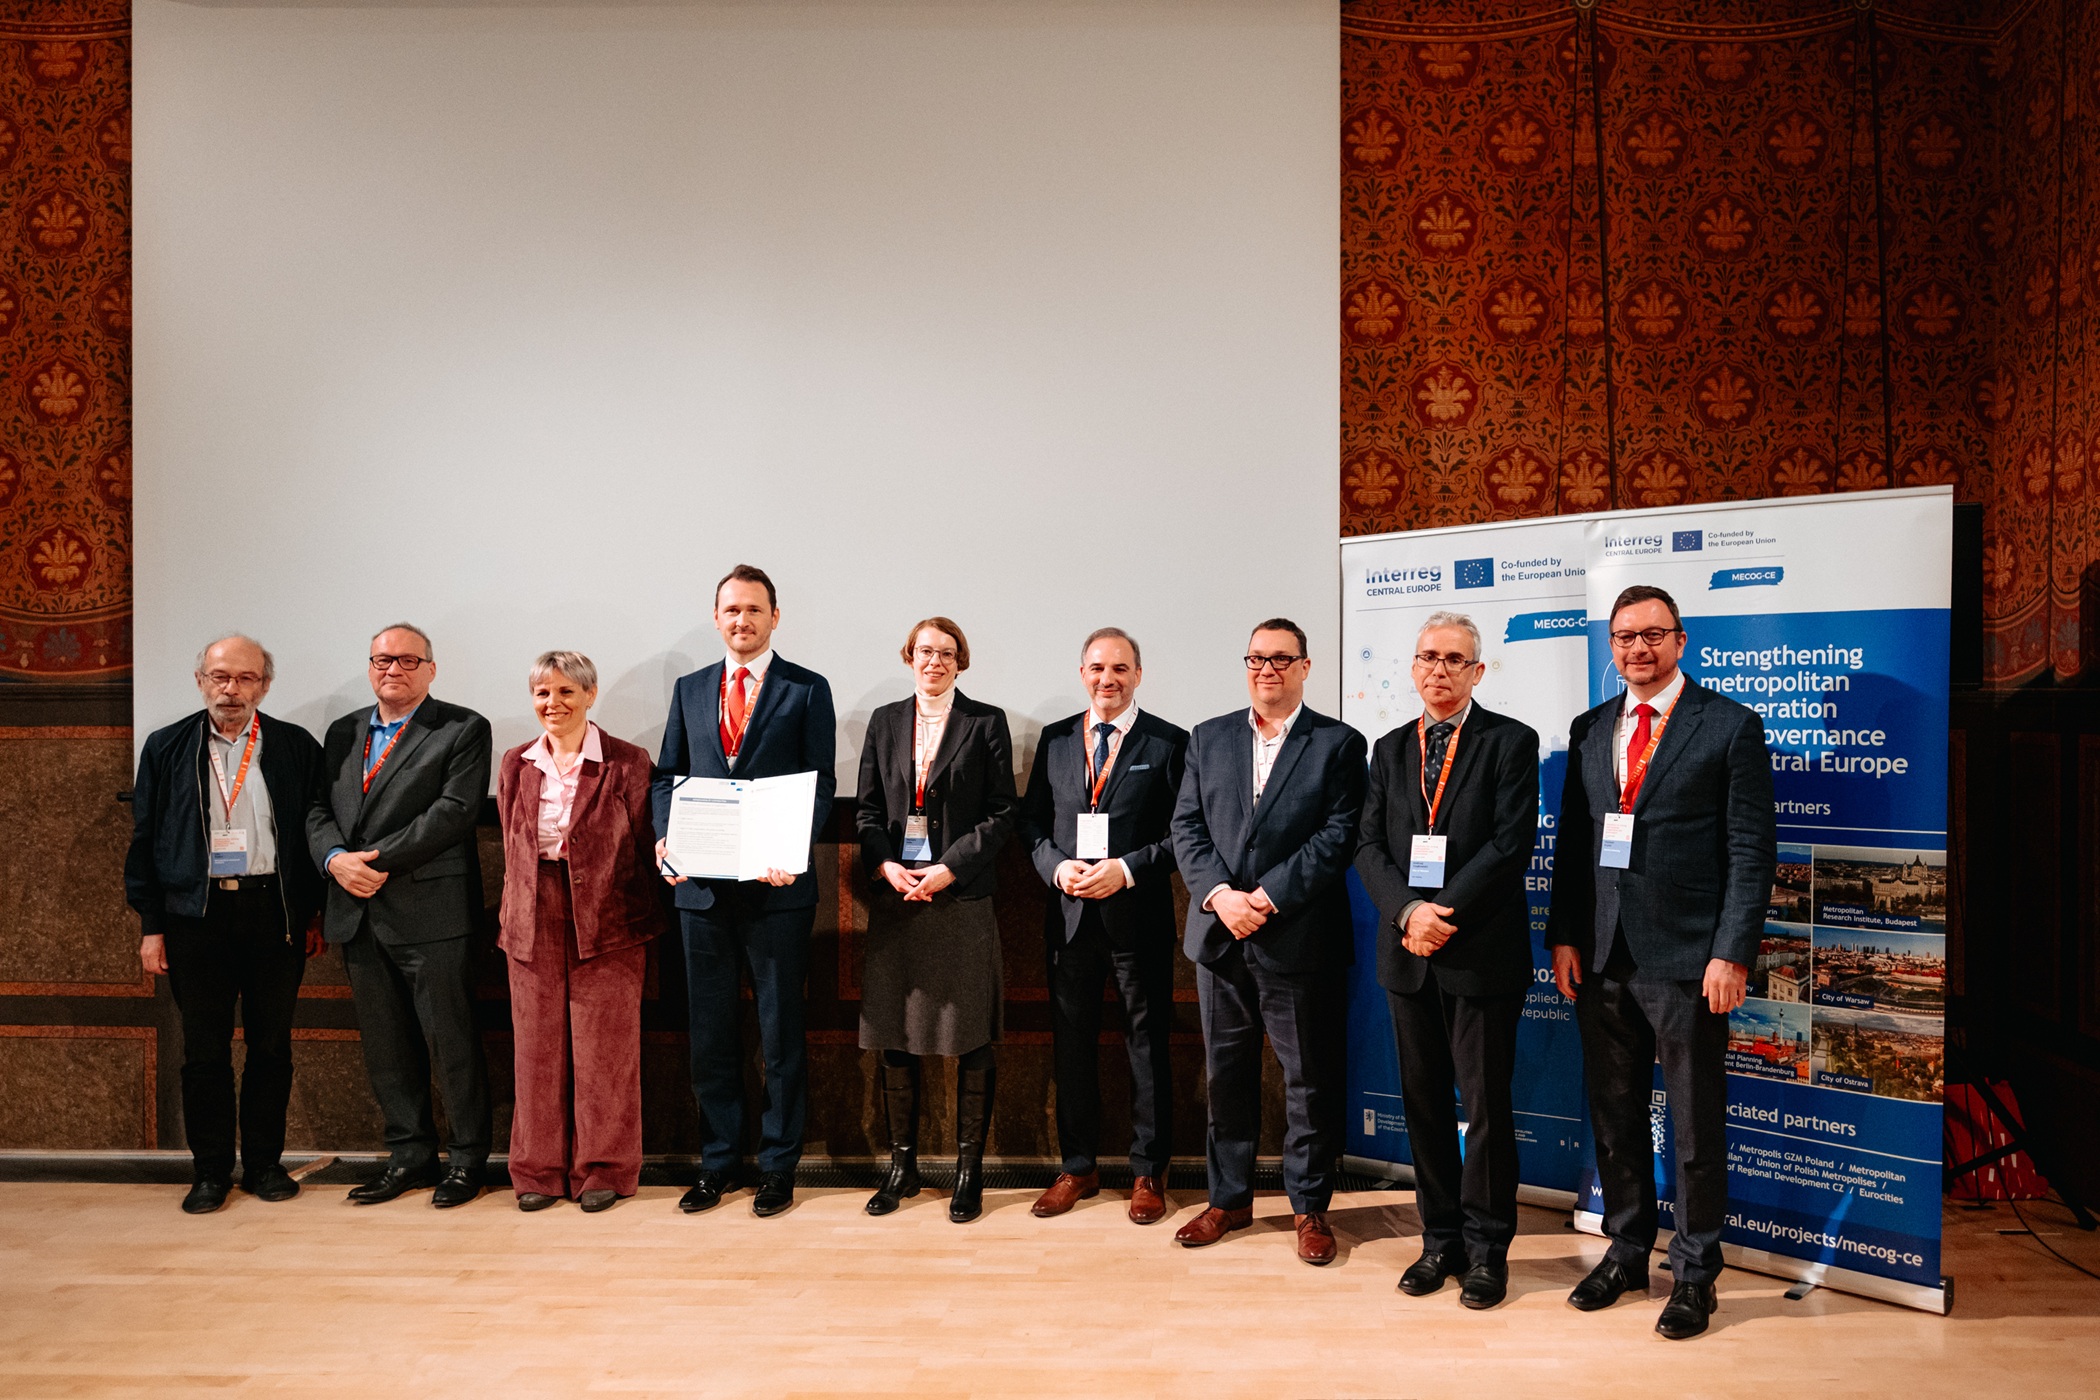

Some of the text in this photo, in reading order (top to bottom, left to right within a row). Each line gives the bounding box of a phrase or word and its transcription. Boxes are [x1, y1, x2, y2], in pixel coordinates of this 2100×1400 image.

[1605, 534, 1663, 548] Interreg
[1708, 530, 1754, 539] Co-funded by
[1720, 539, 1754, 547] European
[1755, 537, 1777, 545] Union
[1605, 549, 1634, 557] CENTRAL
[1501, 557, 1562, 570] Co-funded by
[1366, 565, 1442, 584] Interreg
[1501, 568, 1586, 582] the European Unio
[1732, 571, 1776, 582] MECOG-CE
[1366, 583, 1442, 597] CENTRAL EUROPE
[1700, 644, 1863, 671] Strengthening
[1700, 671, 1850, 697] metropolitan
[1764, 727, 1886, 746] overnance
[1771, 751, 1909, 779] tral Europe
[1774, 799, 1831, 815] artners
[1823, 905, 1864, 915] Metropolitan
[1823, 913, 1918, 927] Research Institute, Budapest
[1822, 993, 1835, 1003] City
[1845, 996, 1870, 1005] Warsaw
[1737, 1054, 1762, 1065] Planning
[1735, 1061, 1795, 1077] Berlin-Brandenburg
[1821, 1074, 1833, 1083] City
[1844, 1077, 1869, 1088] Ostrava
[1784, 1113, 1857, 1137] partners
[1739, 1144, 1782, 1158] Metropolis
[1784, 1152, 1803, 1163] GZM
[1805, 1156, 1834, 1169] Poland
[1849, 1164, 1906, 1182] Metropolitan
[1757, 1158, 1781, 1169] Union
[1783, 1163, 1792, 1171] of
[1795, 1165, 1819, 1177] Polish
[1822, 1171, 1877, 1188] Metropolises
[1727, 1163, 1735, 1171] of
[1737, 1164, 1772, 1179] Regional
[1775, 1172, 1830, 1190] Development
[1832, 1183, 1844, 1193] CZ
[1859, 1188, 1904, 1205] Eurocities
